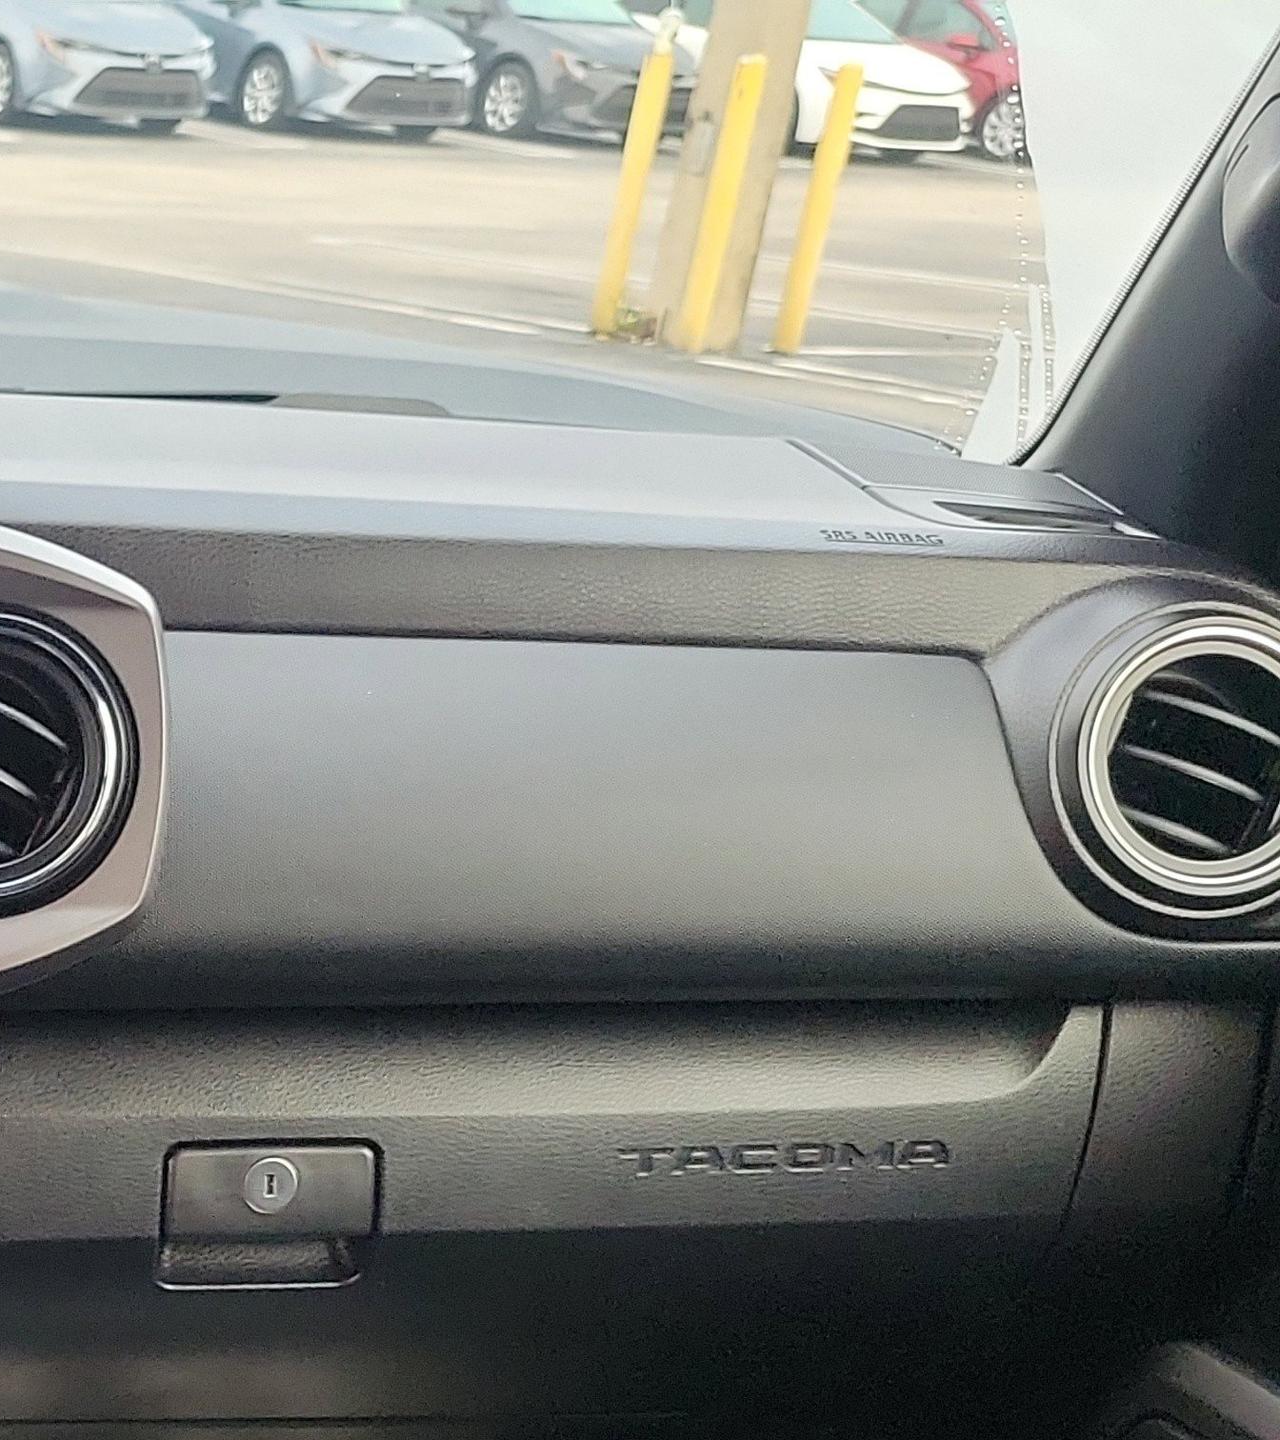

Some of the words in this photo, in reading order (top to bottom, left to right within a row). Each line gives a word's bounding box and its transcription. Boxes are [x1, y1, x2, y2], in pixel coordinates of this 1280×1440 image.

[819, 528, 857, 542] SRS
[864, 529, 944, 546] AIRBAG
[615, 1139, 951, 1178] TACOMA
